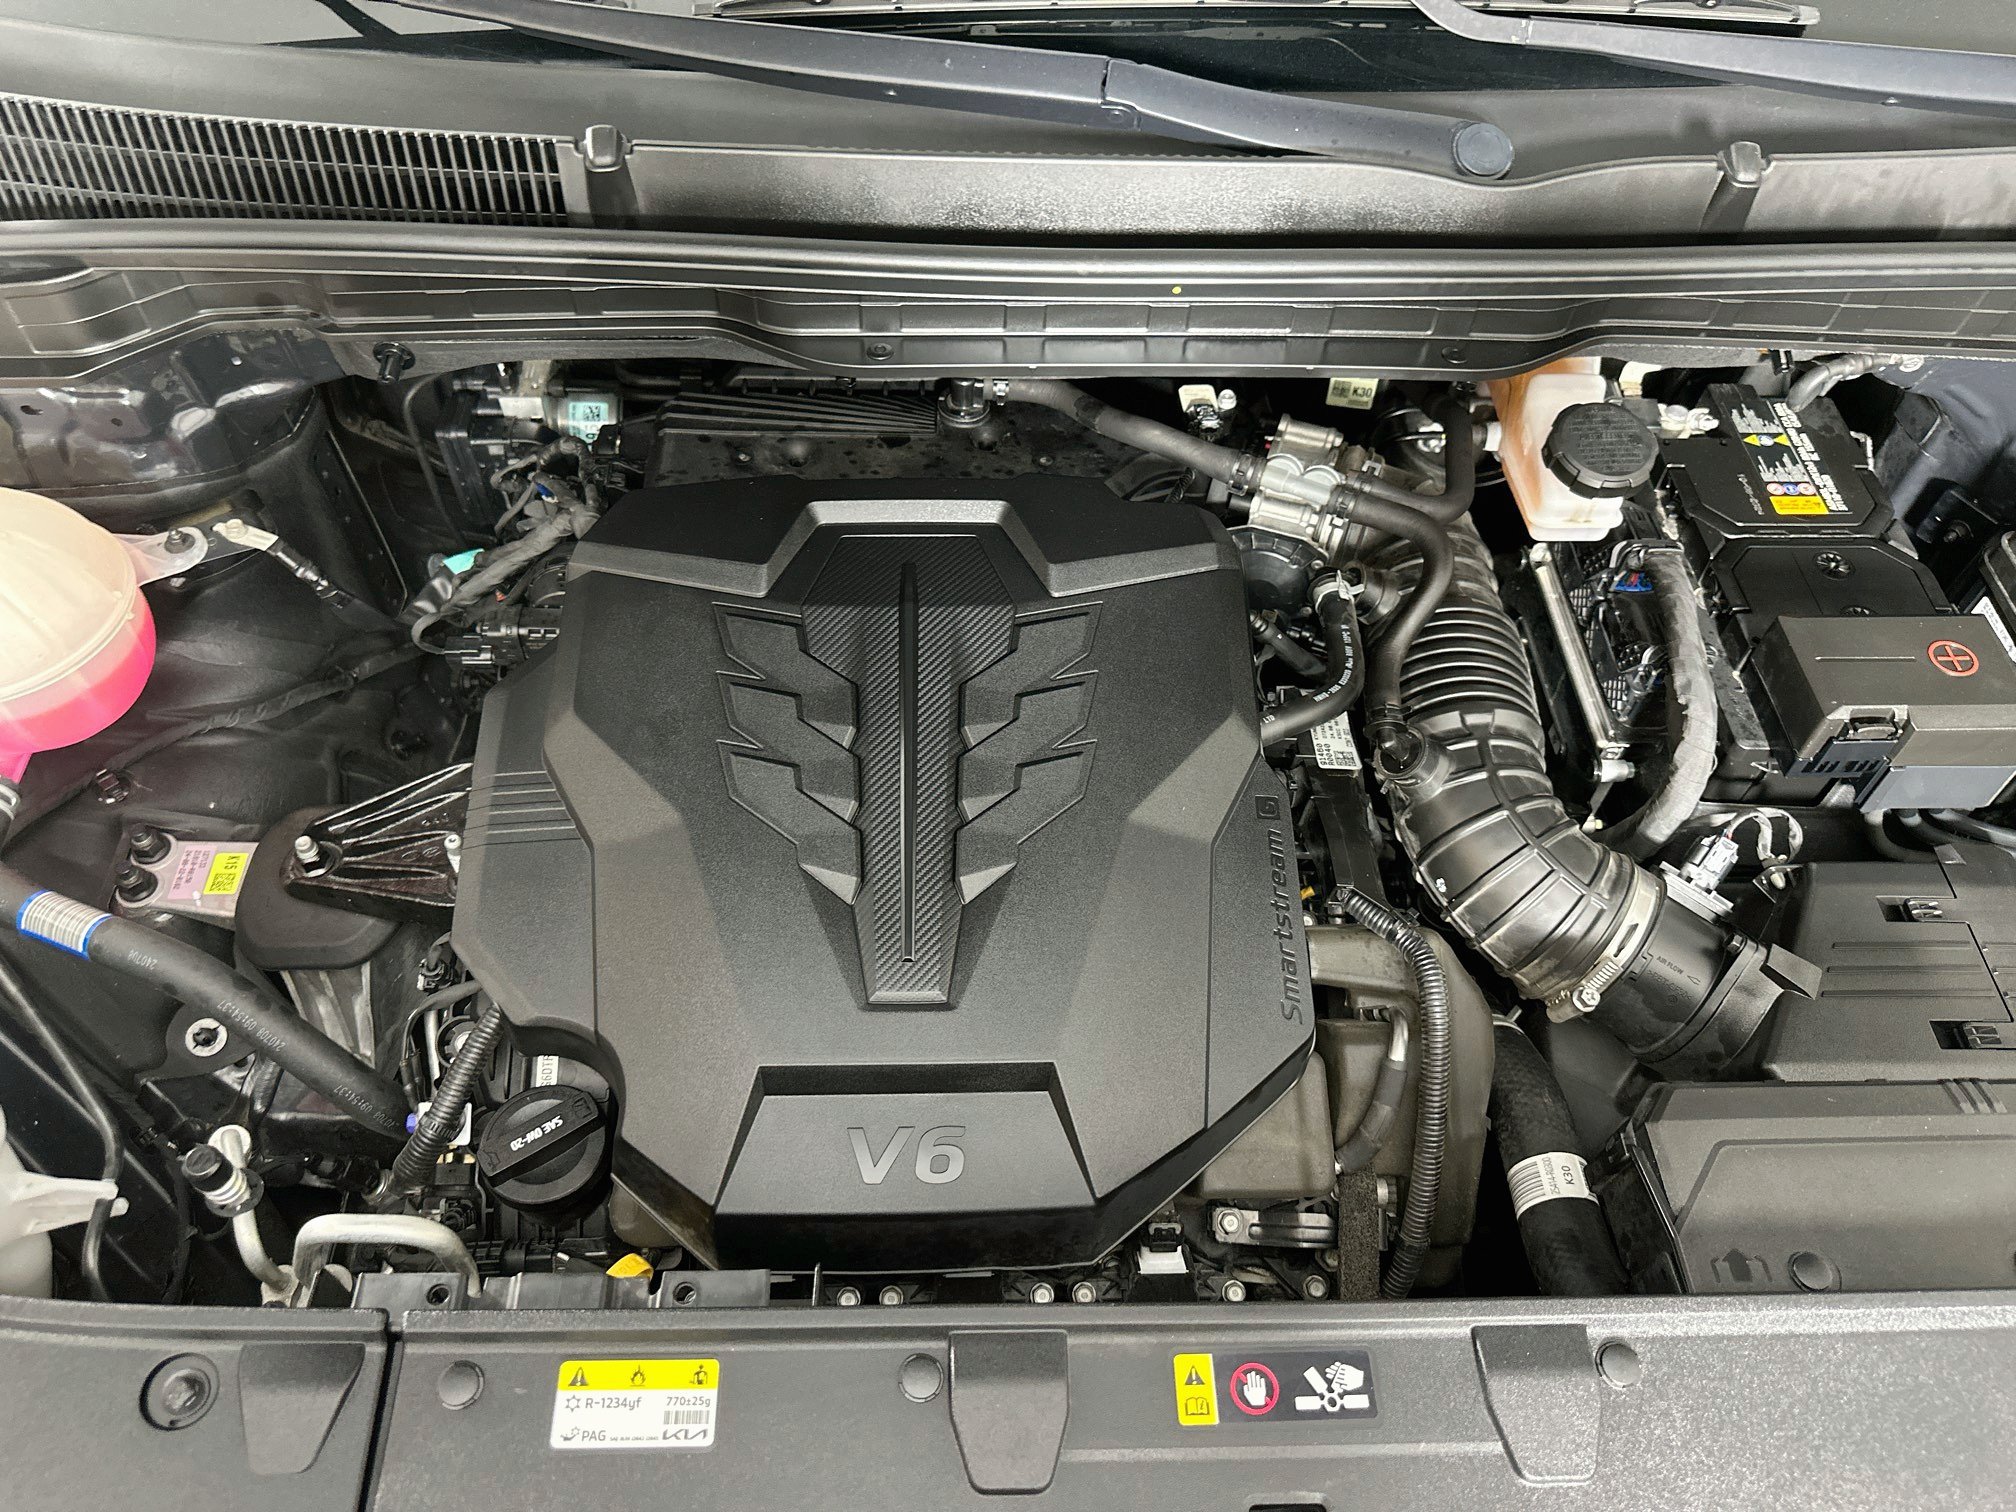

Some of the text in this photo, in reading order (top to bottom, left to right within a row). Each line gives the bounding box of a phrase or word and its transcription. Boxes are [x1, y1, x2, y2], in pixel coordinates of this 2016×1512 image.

[1352, 387, 1373, 398] K30
[1267, 828, 1303, 1025] Smartstream
[1656, 955, 1684, 974] AIR FLOW
[217, 1000, 287, 1052] 240708 09:54:37
[334, 1084, 373, 1114] 09:54:37
[510, 1115, 564, 1152] SAE 0W-20
[846, 1125, 966, 1186] V6
[1561, 1165, 1575, 1185] K30
[585, 1396, 642, 1411] R-1234yf
[666, 1396, 711, 1408] 770±25g
[581, 1430, 606, 1442] PAG
